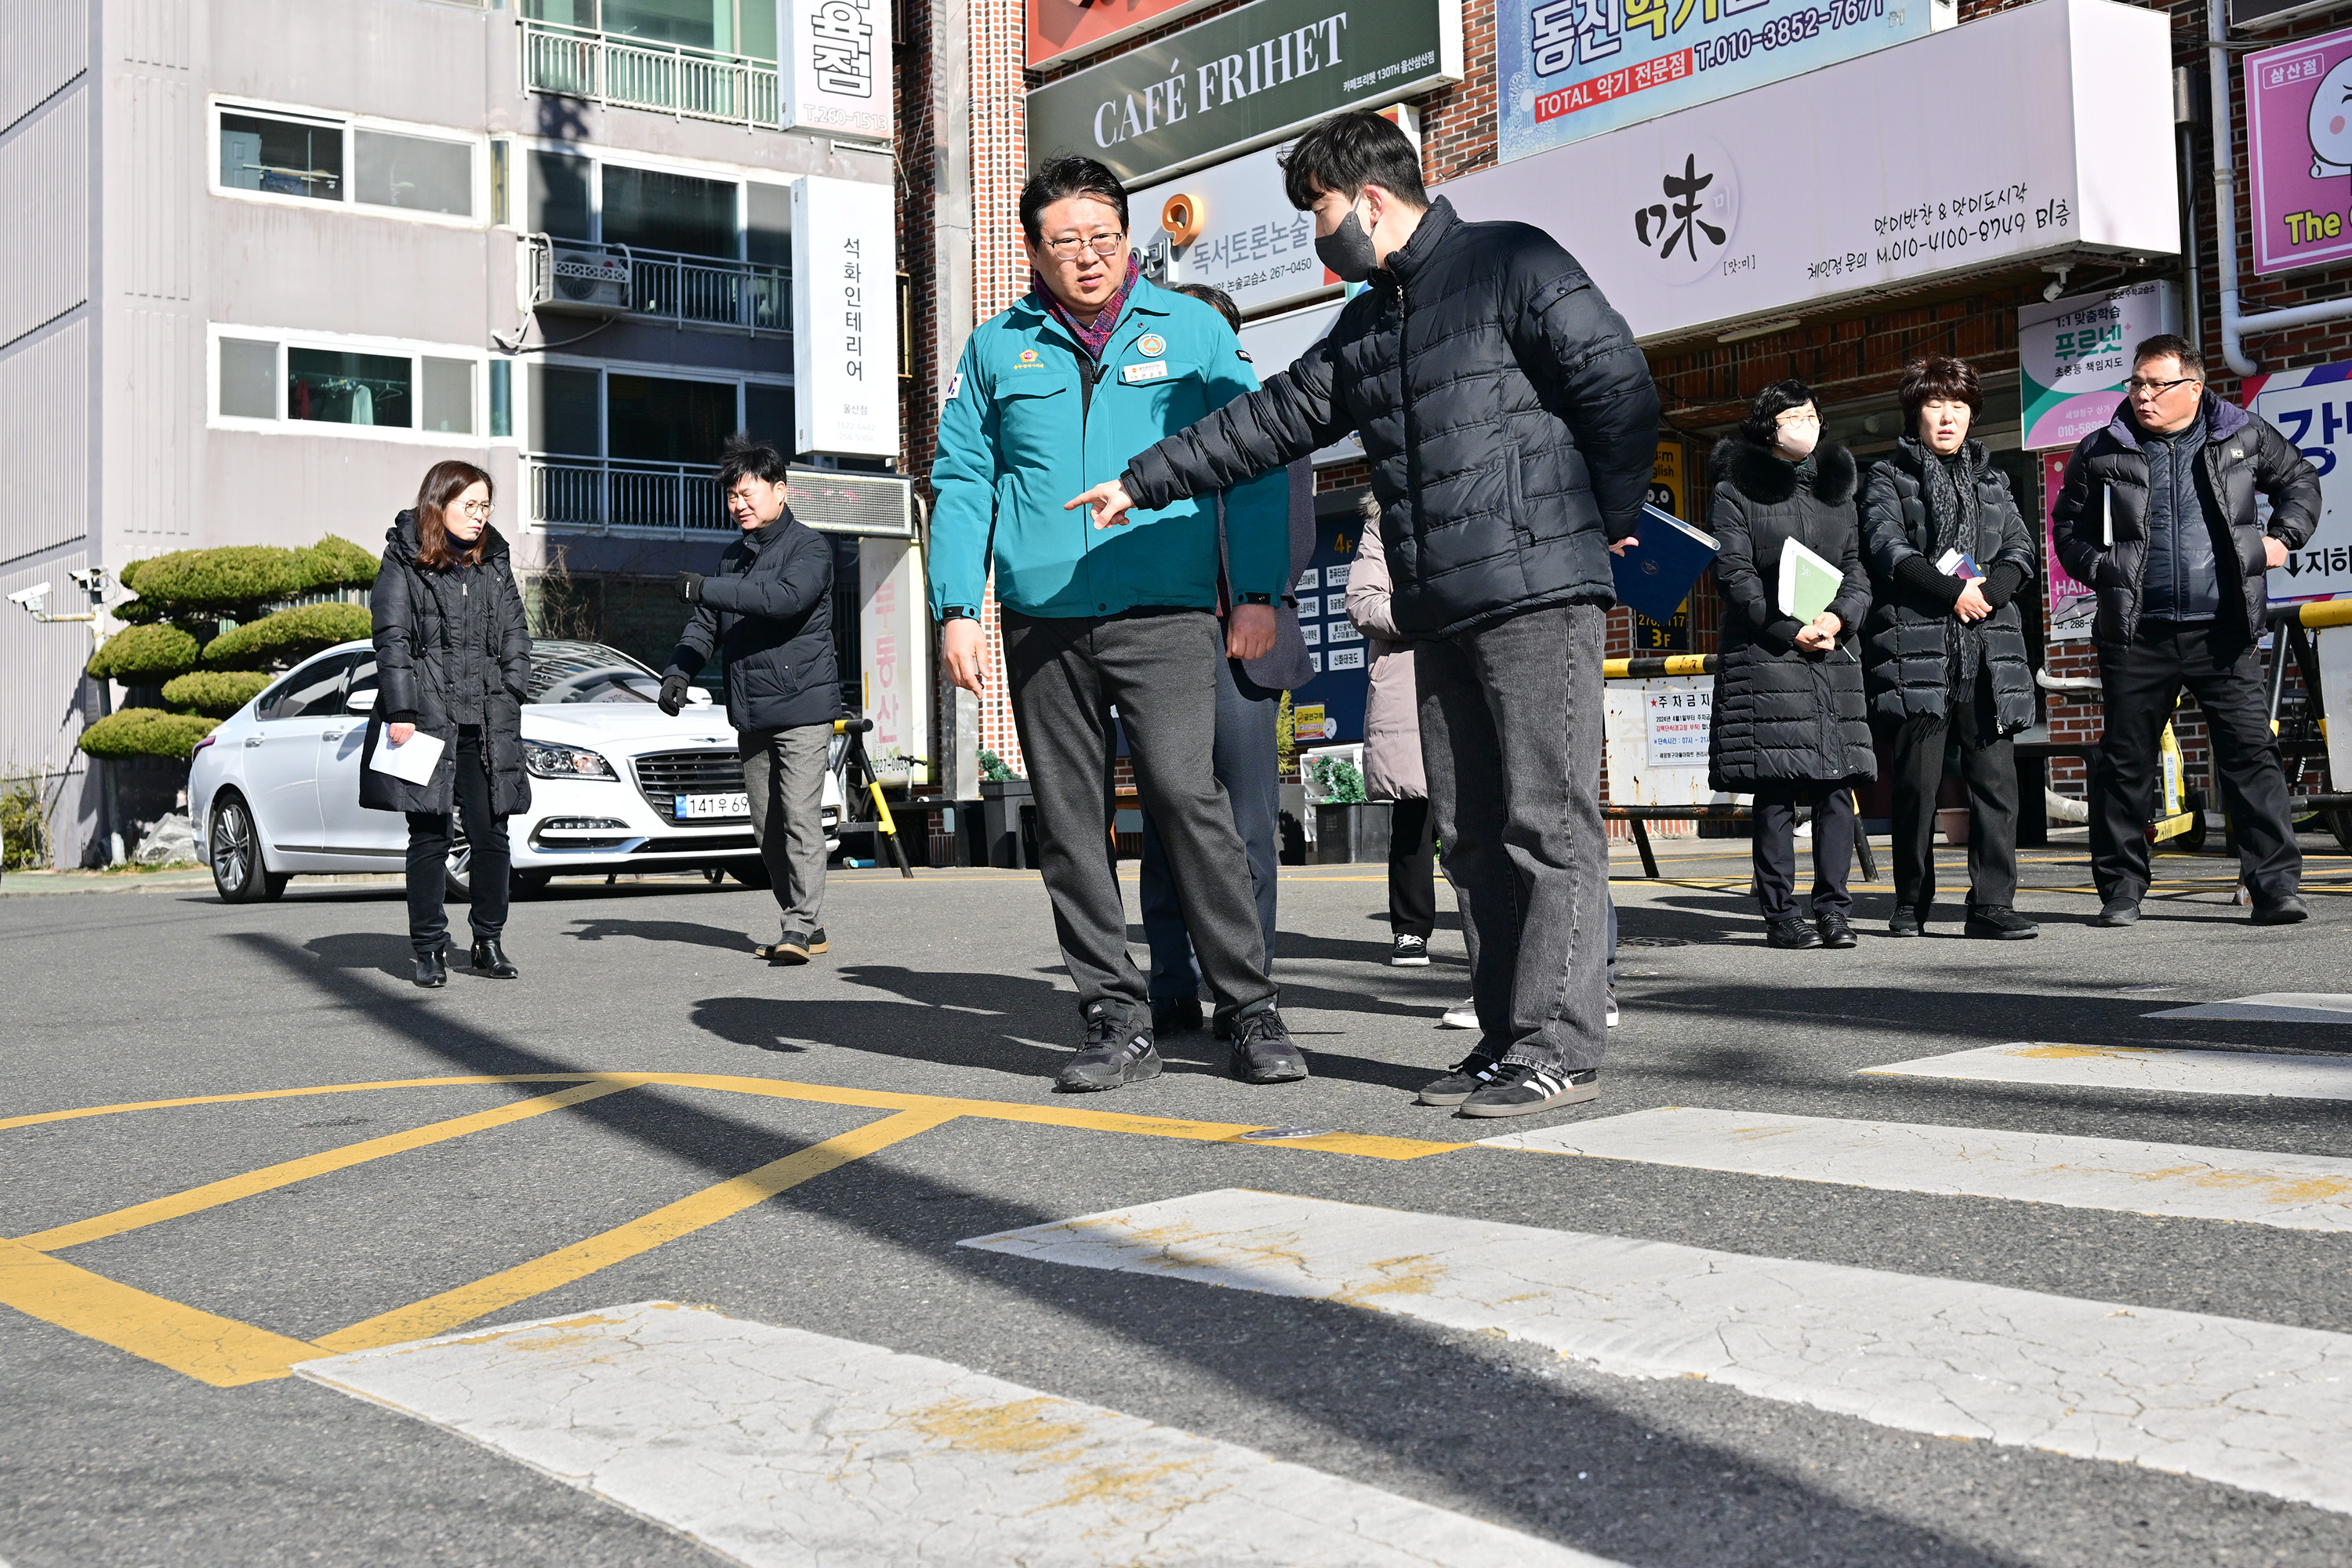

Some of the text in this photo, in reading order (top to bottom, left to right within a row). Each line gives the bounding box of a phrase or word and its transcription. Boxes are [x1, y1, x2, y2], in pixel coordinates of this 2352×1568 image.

[811, 0, 873, 99] 육점
[1377, 64, 1399, 81] 130TH
[1400, 50, 1435, 74] 울산삼산점
[1094, 12, 1347, 149] CAFÉ FRIHET
[1538, 51, 1686, 118] TOTAL 악기 전문점
[2270, 60, 2318, 85] 삼산점
[804, 103, 888, 132] T.260-1513
[1635, 153, 1726, 262] 味
[1938, 203, 1947, 220] &
[1192, 212, 1310, 275] 독서토론논술
[1877, 212, 2027, 264] M.010-4100-8749
[2285, 211, 2342, 245] The
[1227, 270, 1268, 292] 논술교습소
[1270, 257, 1312, 281] 267-0450
[844, 238, 862, 382] 석화인테리어
[2055, 305, 2122, 328] 1:1 맞춤학습
[2055, 324, 2122, 361] 푸르넷
[2055, 357, 2124, 378] 초중등 책임지도
[843, 403, 868, 416] 울산점
[1652, 464, 1675, 479] glish
[875, 577, 900, 745] 부동산
[689, 797, 728, 815] 141우
